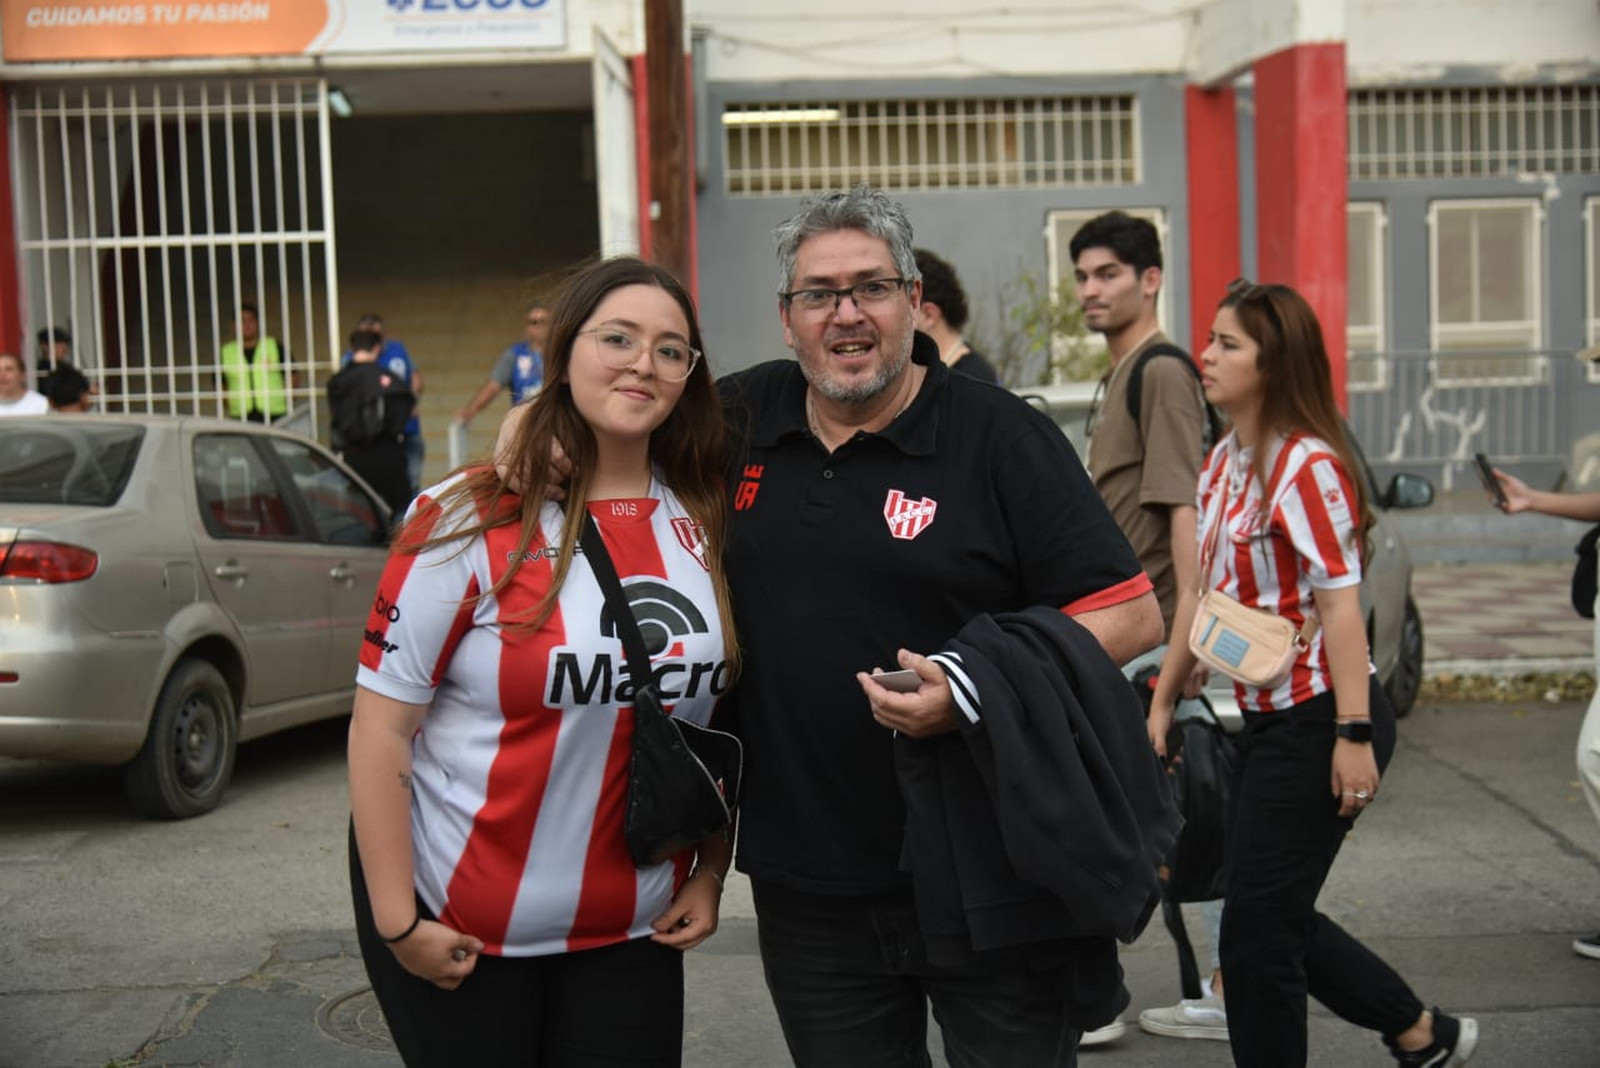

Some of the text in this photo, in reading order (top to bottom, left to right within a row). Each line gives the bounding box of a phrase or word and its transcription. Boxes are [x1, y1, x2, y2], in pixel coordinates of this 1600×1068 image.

[26, 1, 270, 28] CUIDAMOS TU PASIÓN
[611, 502, 639, 516] 1918
